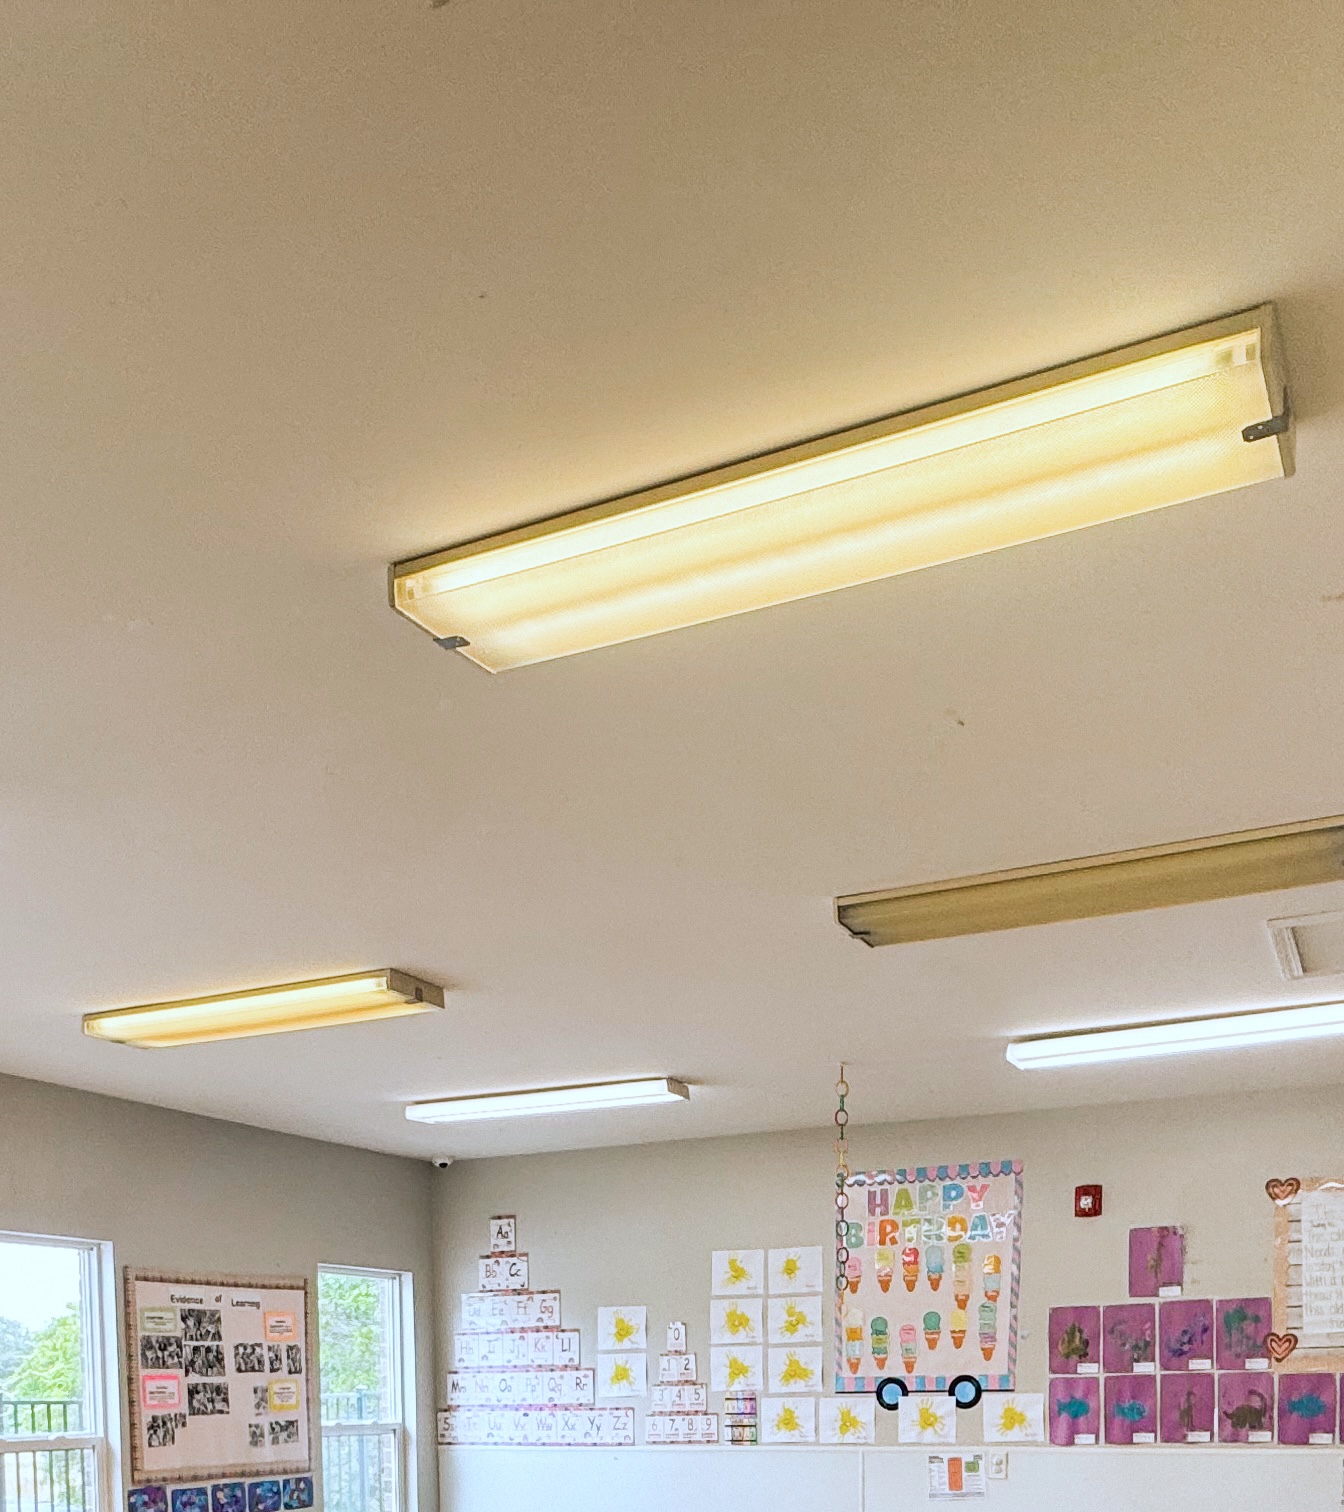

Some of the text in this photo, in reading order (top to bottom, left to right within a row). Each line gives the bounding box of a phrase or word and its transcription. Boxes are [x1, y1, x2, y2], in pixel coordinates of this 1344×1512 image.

[867, 1183, 990, 1217] HAPPY
[170, 1293, 261, 1310] Evidence of Learning
[540, 1300, 555, 1319] Gg
[674, 1327, 681, 1341] 0
[666, 1357, 691, 1371] 1 2
[548, 1379, 562, 1397] Qq
[576, 1376, 589, 1391] Rr
[675, 1388, 682, 1400] 4
[694, 1388, 701, 1400] 5
[563, 1416, 577, 1432] Xx
[587, 1416, 602, 1435] Yy
[612, 1415, 628, 1431] Zz
[651, 1417, 712, 1431] 6 7 8 9
